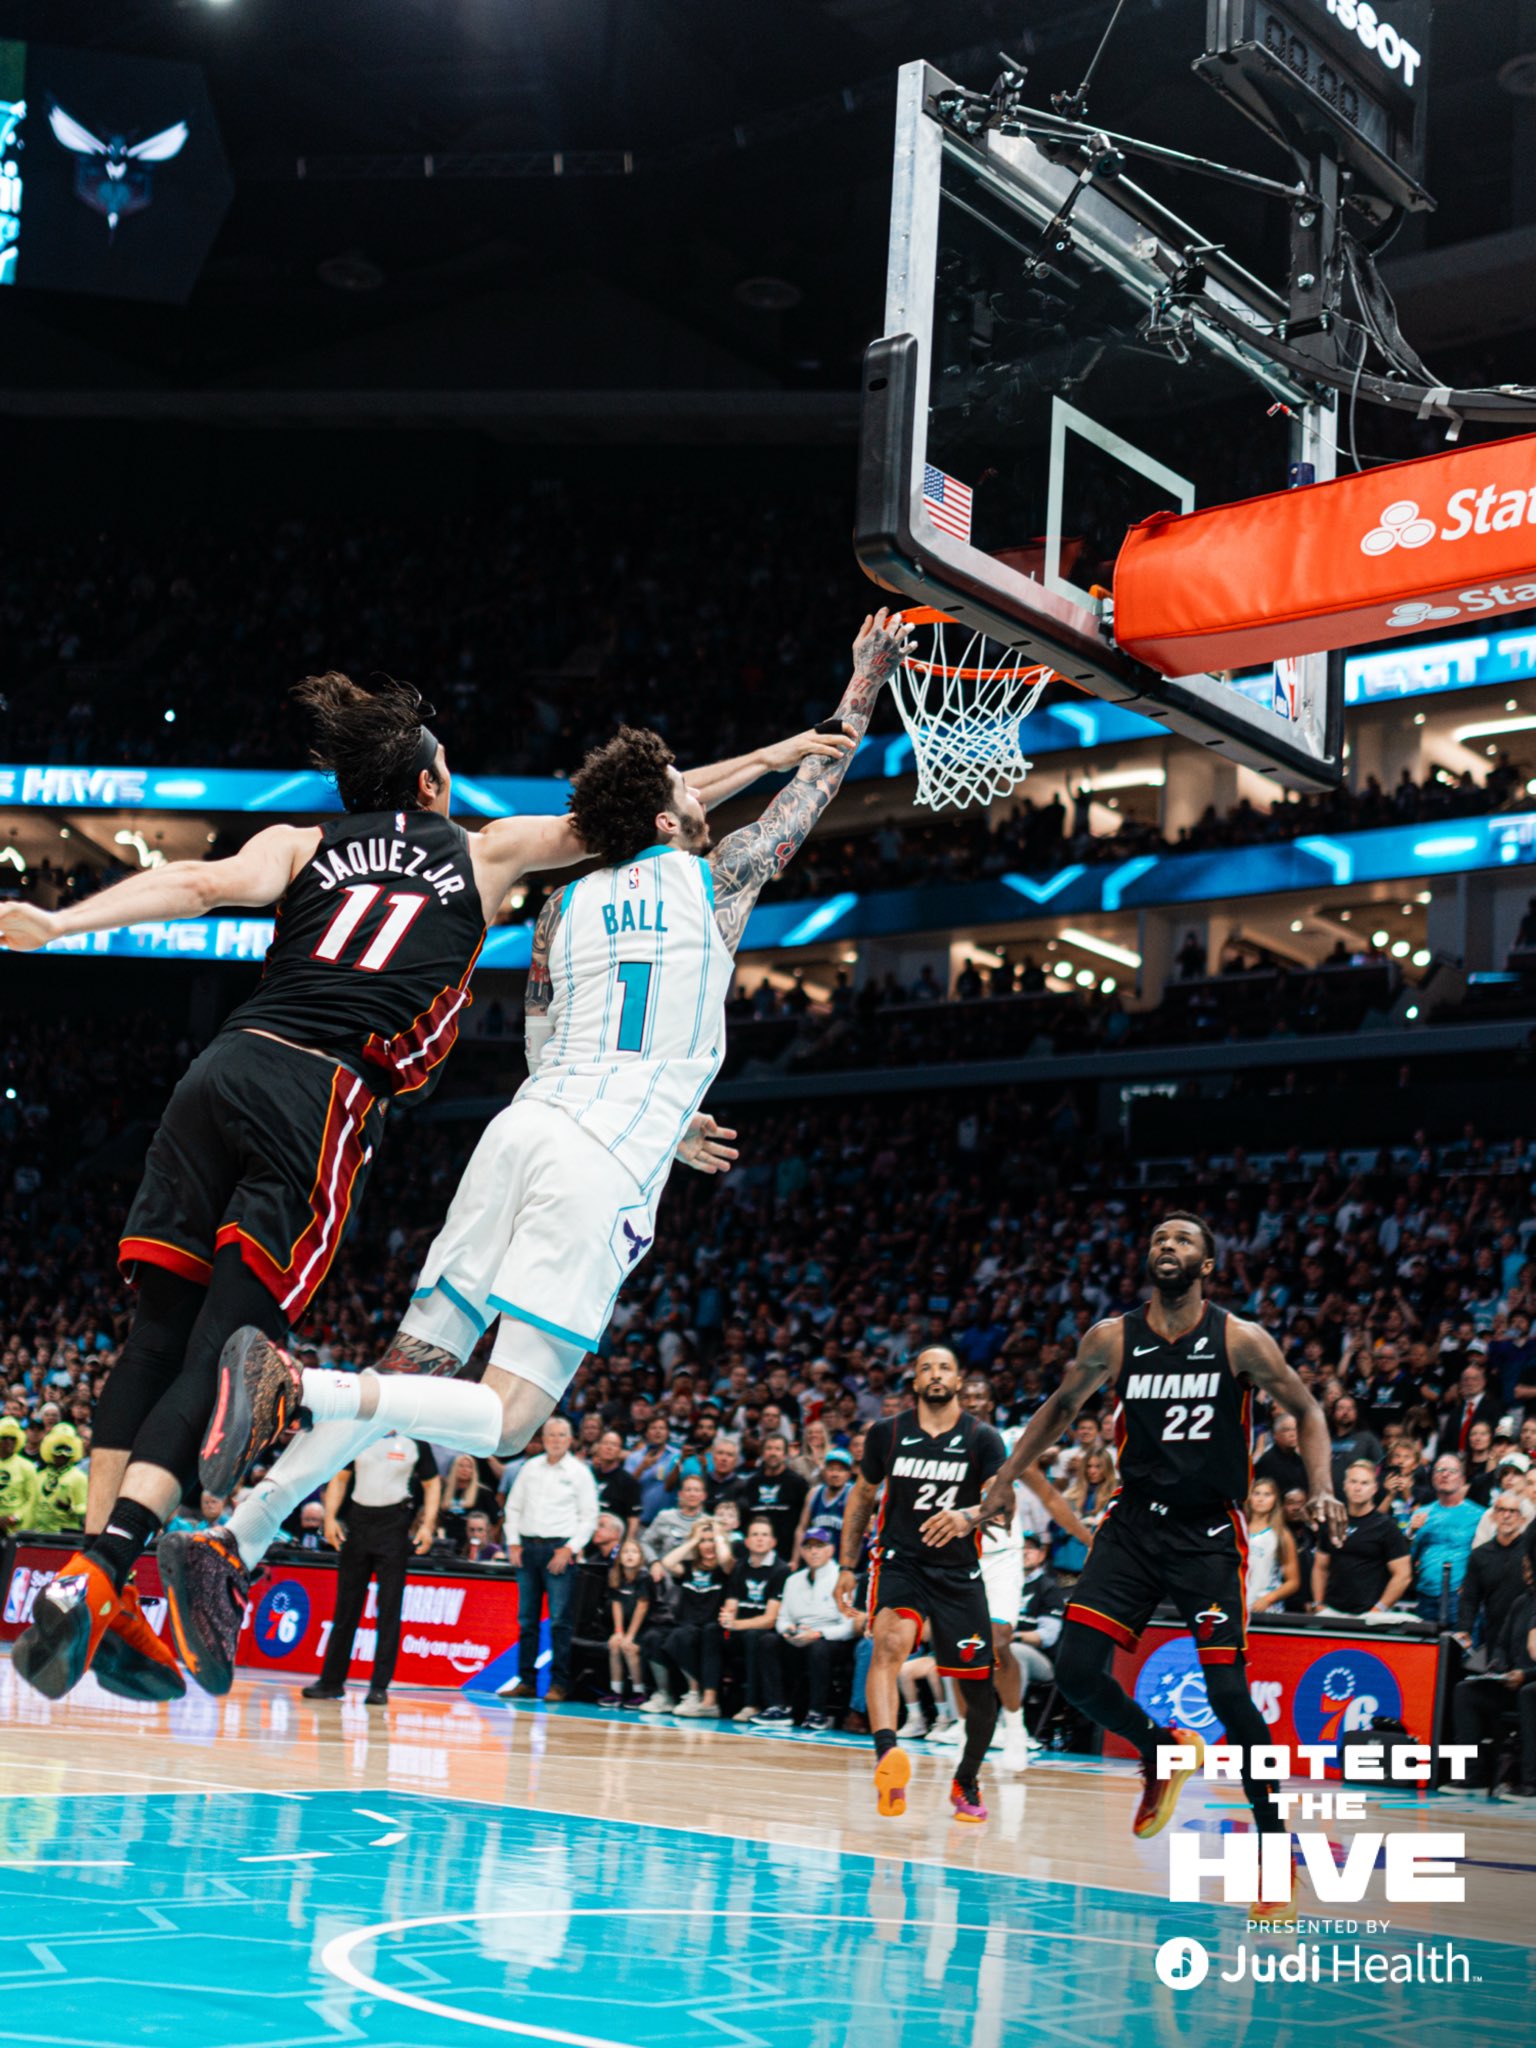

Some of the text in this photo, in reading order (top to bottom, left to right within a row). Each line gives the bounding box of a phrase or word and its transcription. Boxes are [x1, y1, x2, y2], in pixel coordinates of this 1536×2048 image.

[1326, 0, 1421, 87] SSOT
[311, 838, 465, 905] JAQUEZ JR.
[309, 883, 430, 972] 11
[602, 899, 668, 935] BALL
[616, 961, 653, 1052] 1
[1126, 1372, 1221, 1399] MIAMI
[1162, 1404, 1215, 1440] 22
[891, 1457, 968, 1482] MIAMI
[913, 1483, 959, 1511] 24
[264, 1609, 300, 1643] 76
[1318, 1693, 1379, 1742] 76
